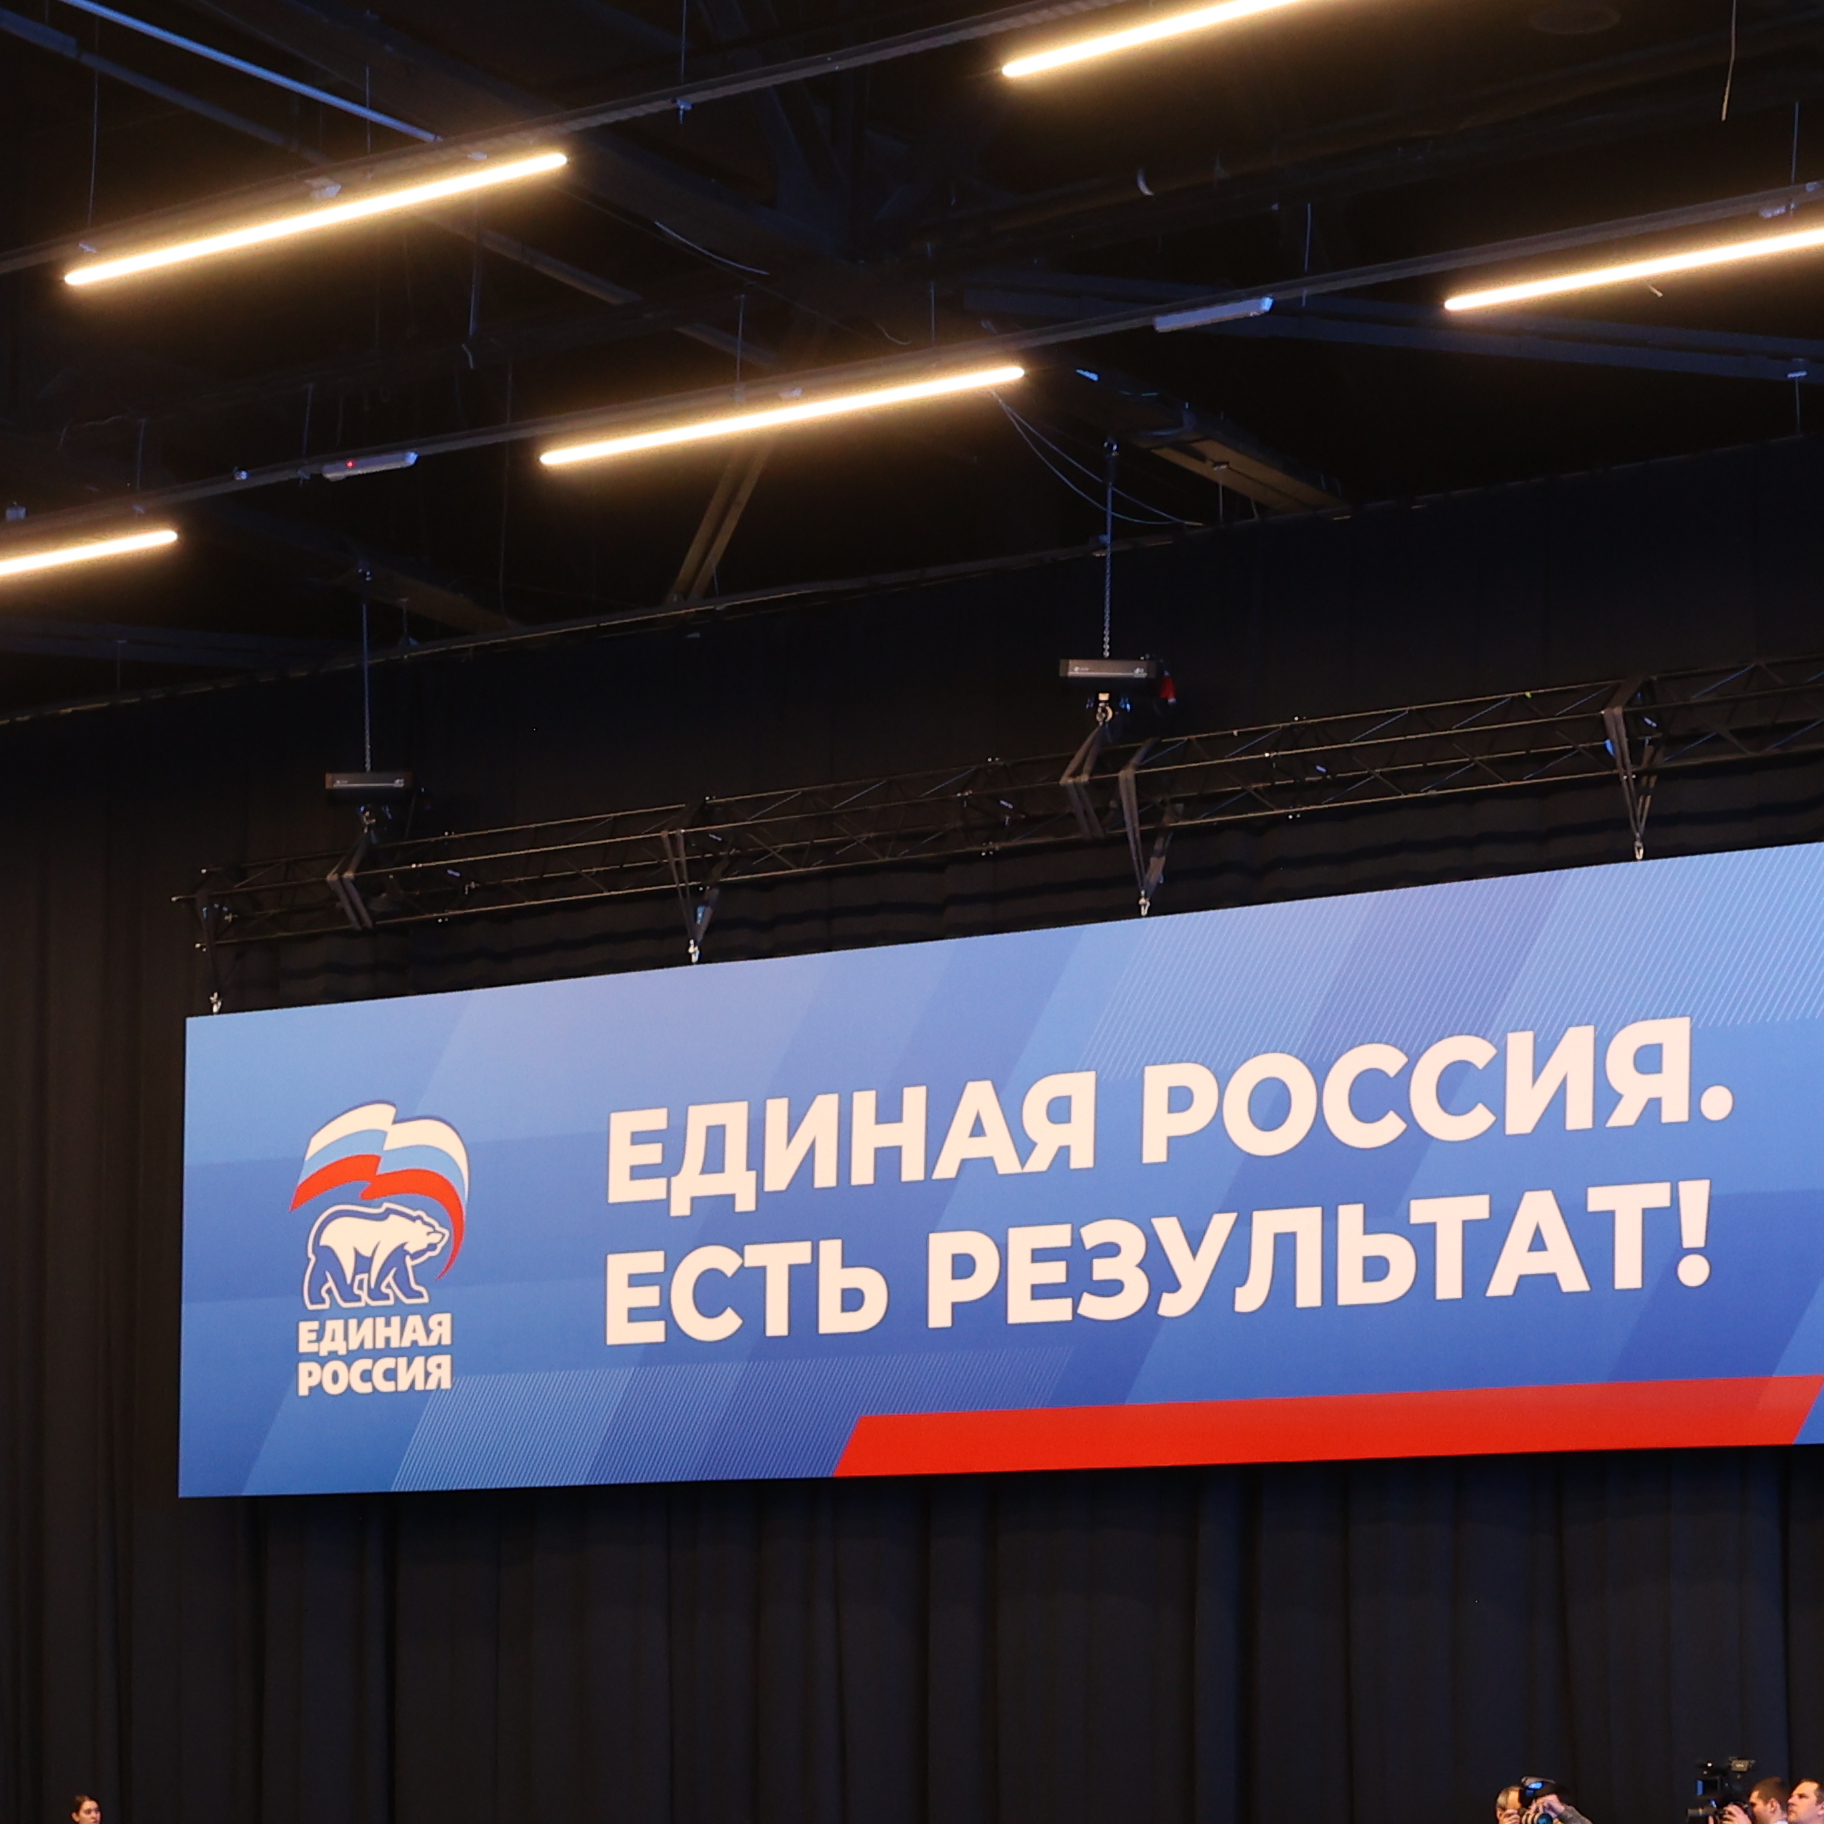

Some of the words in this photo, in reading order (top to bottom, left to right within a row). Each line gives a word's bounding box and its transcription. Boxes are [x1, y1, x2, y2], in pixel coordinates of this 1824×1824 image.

[608, 1071, 1096, 1217] ЕДИНАЯ
[1143, 1016, 1733, 1164] РОССИЯ.
[606, 1239, 887, 1345] ЕСТЬ
[928, 1180, 1710, 1328] РЕЗУЛЬТАТ!
[297, 1312, 452, 1357] ЕДИНАЯ
[297, 1354, 452, 1397] РОССИЯ
